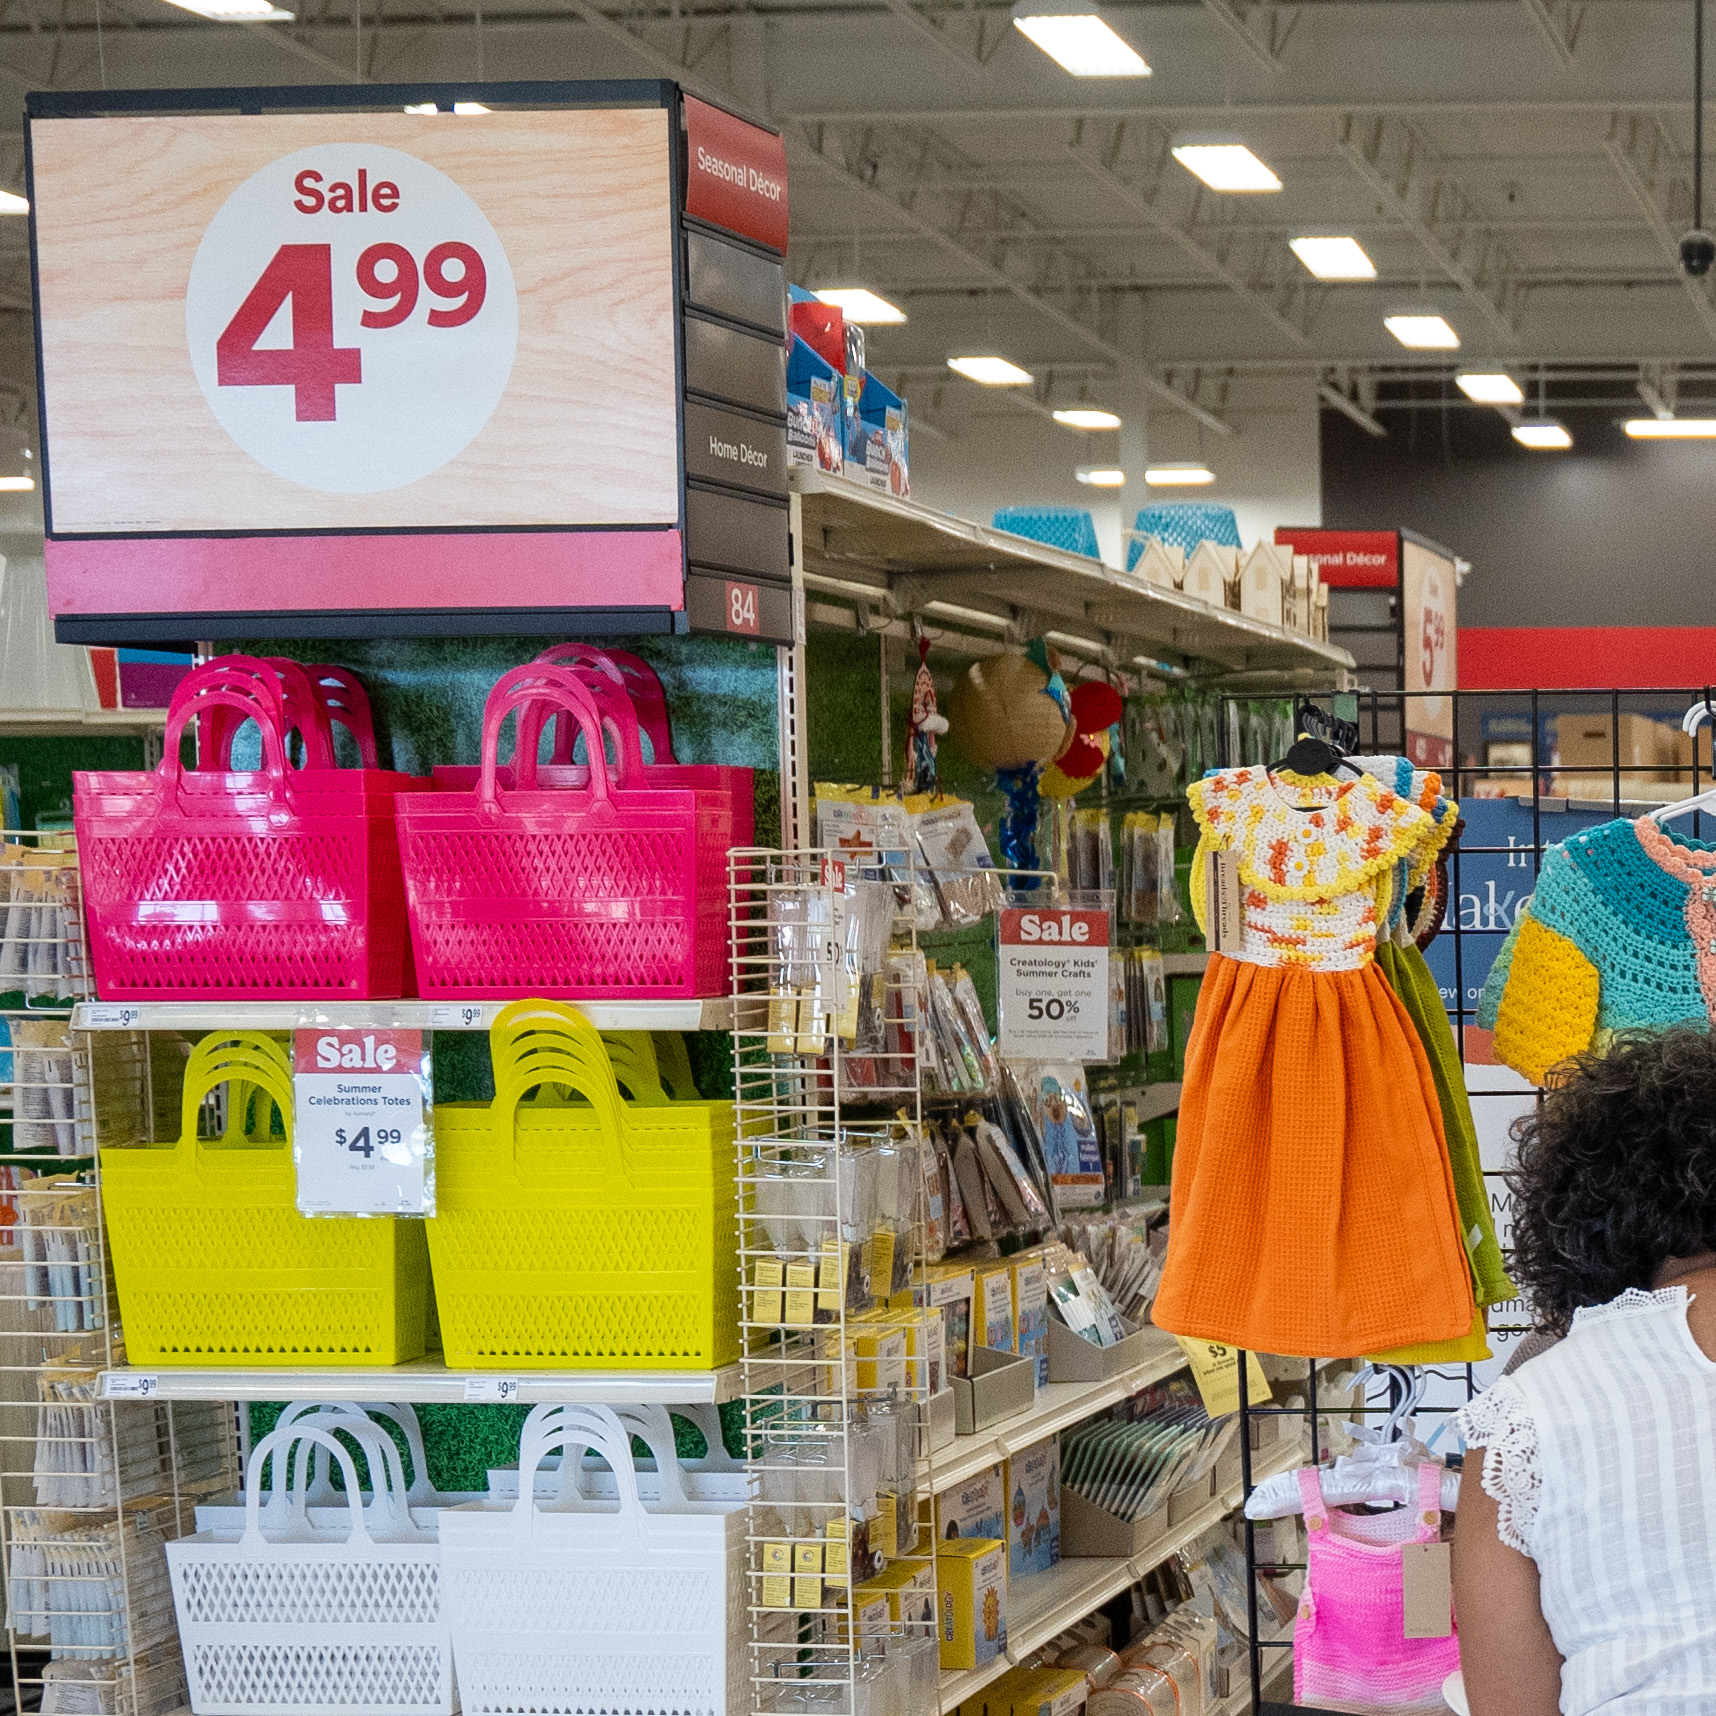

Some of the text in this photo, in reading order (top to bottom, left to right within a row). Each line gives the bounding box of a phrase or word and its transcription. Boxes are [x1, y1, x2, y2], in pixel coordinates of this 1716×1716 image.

[698, 147, 781, 202] Seasonal Décor
[294, 169, 401, 214] Sale
[709, 436, 767, 468] Home Décor
[1310, 553, 1343, 566] onal
[731, 588, 755, 627] 84
[1020, 914, 1090, 942] Sale
[1016, 968, 1092, 978] Summer Crafts
[1057, 989, 1072, 998] get
[1028, 998, 1080, 1020] 50%
[316, 1036, 397, 1071] Sale
[308, 1095, 411, 1107] Celebrations Totes
[337, 1084, 382, 1094] Summer
